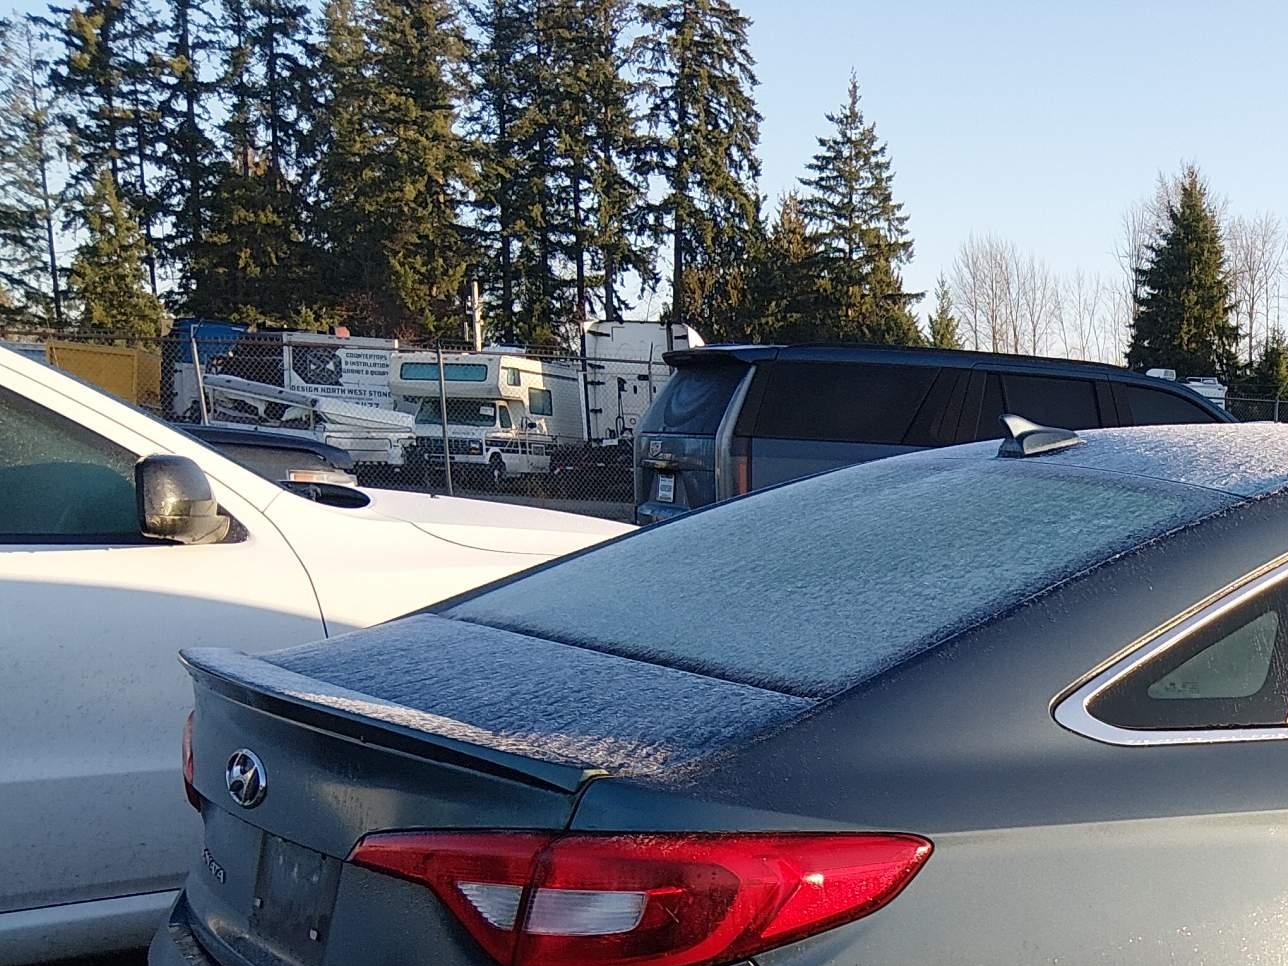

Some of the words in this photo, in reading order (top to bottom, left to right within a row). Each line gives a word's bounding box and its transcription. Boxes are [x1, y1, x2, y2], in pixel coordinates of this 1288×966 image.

[291, 384, 319, 393] DESIGN
[320, 387, 346, 395] NORTH
[347, 388, 367, 397] WEST
